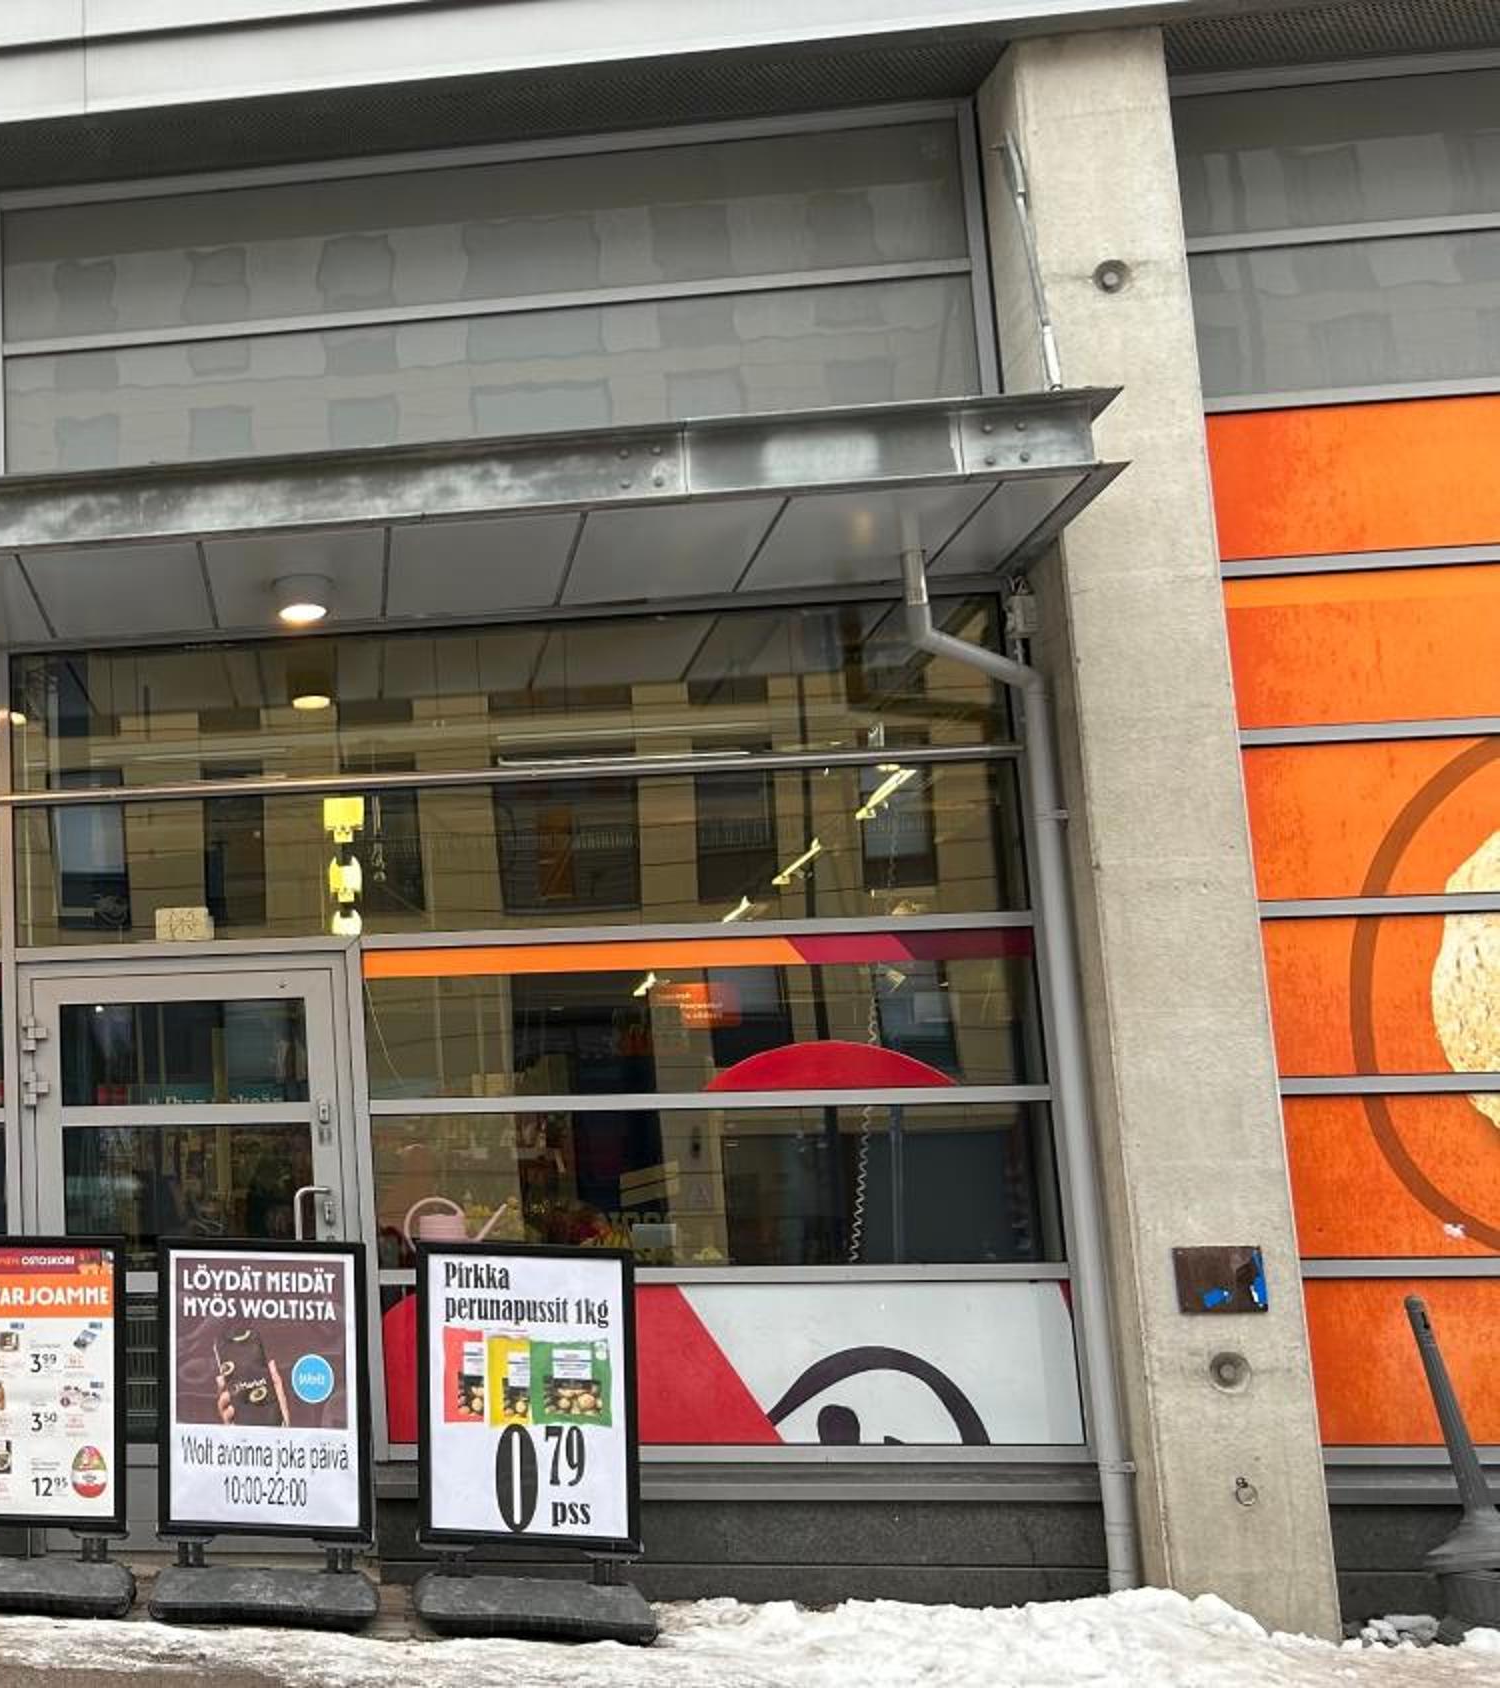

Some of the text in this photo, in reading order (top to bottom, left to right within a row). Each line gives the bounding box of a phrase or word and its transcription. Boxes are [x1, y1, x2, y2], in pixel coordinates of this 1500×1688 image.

[183, 1264, 336, 1294] LÖYDÄT MEIDÄT
[444, 1262, 510, 1290] Pirkka
[183, 1293, 337, 1321] MYÖS WOLTISTA
[445, 1297, 569, 1325] perunapussit
[182, 1437, 348, 1474] Wolt avoinna joka päivä
[224, 1476, 307, 1507] 10:00-22:00
[551, 1501, 591, 1526] pss
